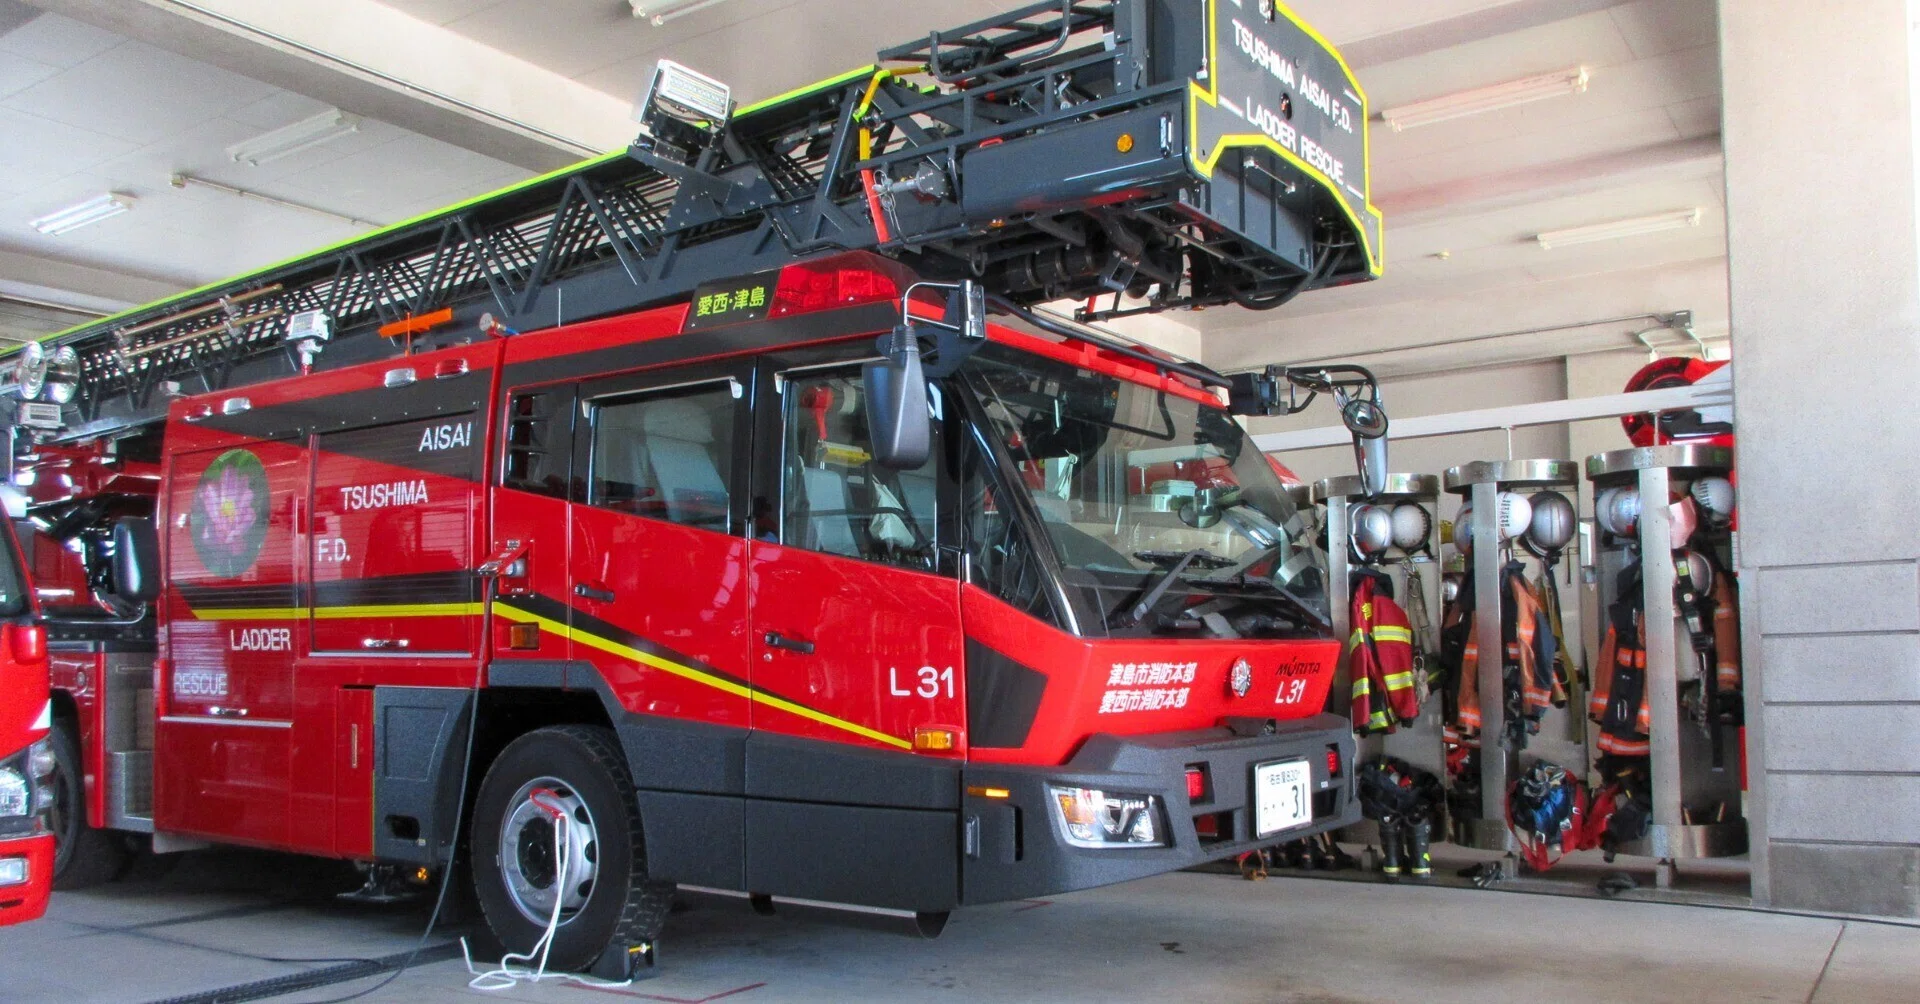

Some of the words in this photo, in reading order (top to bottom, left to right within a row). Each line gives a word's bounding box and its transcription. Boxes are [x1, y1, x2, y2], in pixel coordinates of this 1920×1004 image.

[1232, 18, 1295, 89] TSUSHIMA
[1299, 74, 1330, 116] AISAI
[1331, 99, 1352, 133] F.D.
[1246, 96, 1296, 152] LADDER
[1300, 135, 1344, 185] RESCUE
[419, 422, 471, 452] AISAI
[341, 479, 428, 510] TSUSHIMA
[318, 537, 350, 562] F.D.
[230, 628, 291, 650] LADDER
[173, 672, 227, 695] RESCUE
[1107, 663, 1197, 686] 津島市消防本部
[1099, 688, 1190, 713] 愛西市消防本部
